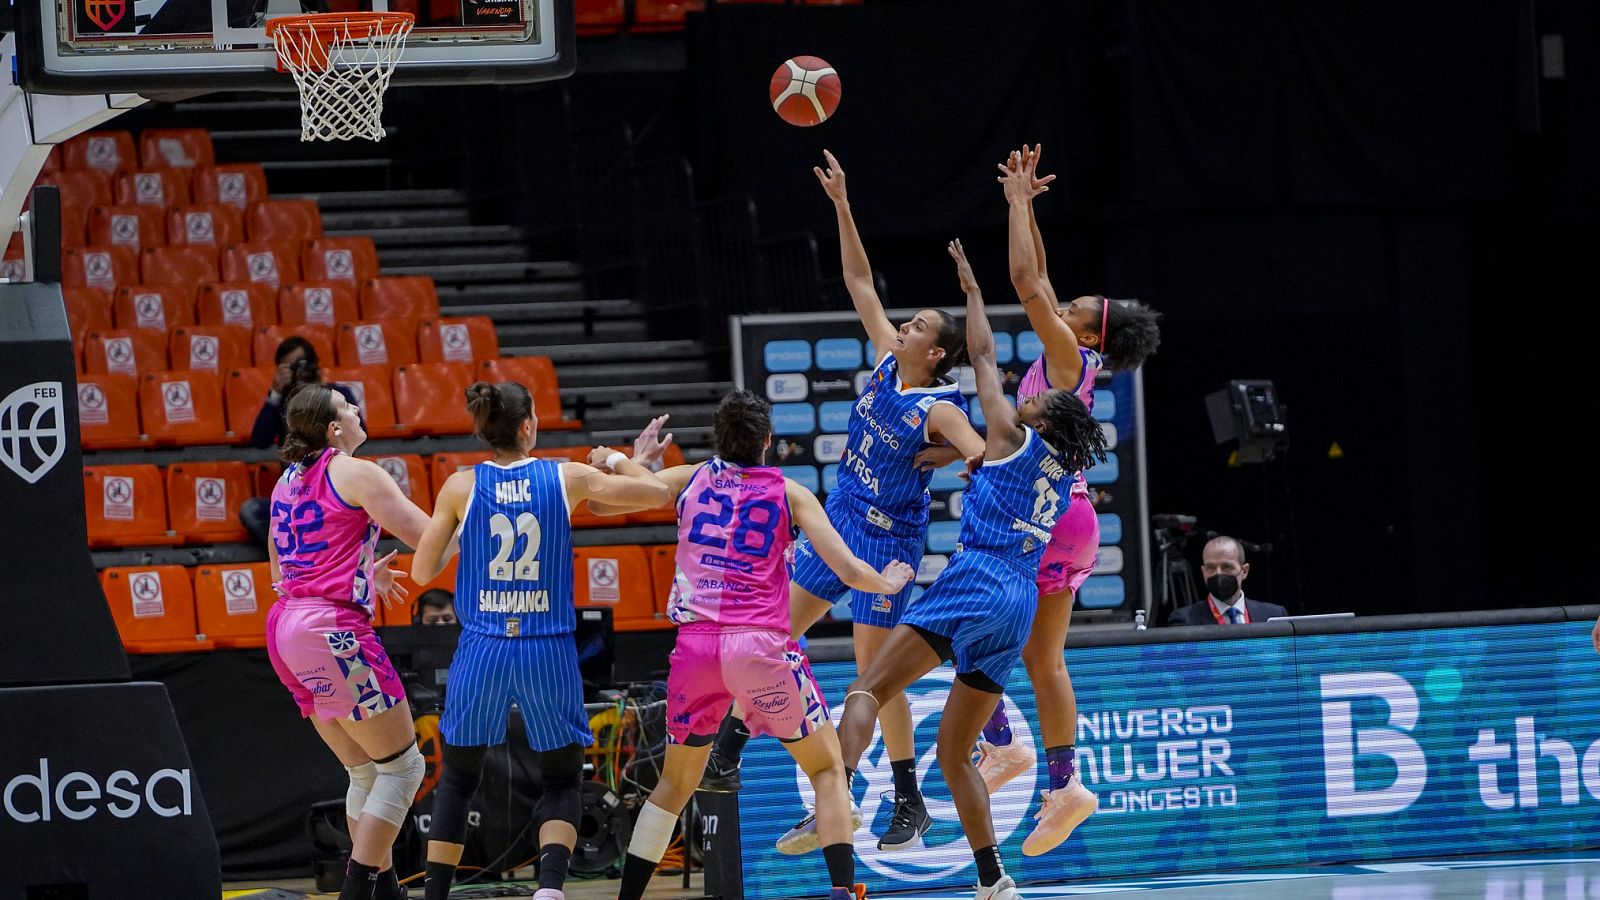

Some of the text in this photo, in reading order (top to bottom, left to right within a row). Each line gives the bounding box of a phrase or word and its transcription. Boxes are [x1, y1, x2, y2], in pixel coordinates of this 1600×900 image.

[476, 7, 514, 15] VALENCIA
[34, 388, 57, 398] FEB
[495, 479, 532, 504] MILIC
[714, 479, 769, 495] SANCHEZ
[272, 500, 329, 555] 32
[688, 487, 781, 558] 28
[489, 511, 541, 581] 22
[479, 589, 550, 612] SALAMANCA
[747, 680, 786, 695] CHOCOLATE
[752, 695, 789, 711] Reybar
[1076, 704, 1233, 741] NIVERSO
[1320, 671, 1428, 818] B
[3, 757, 192, 823] desa
